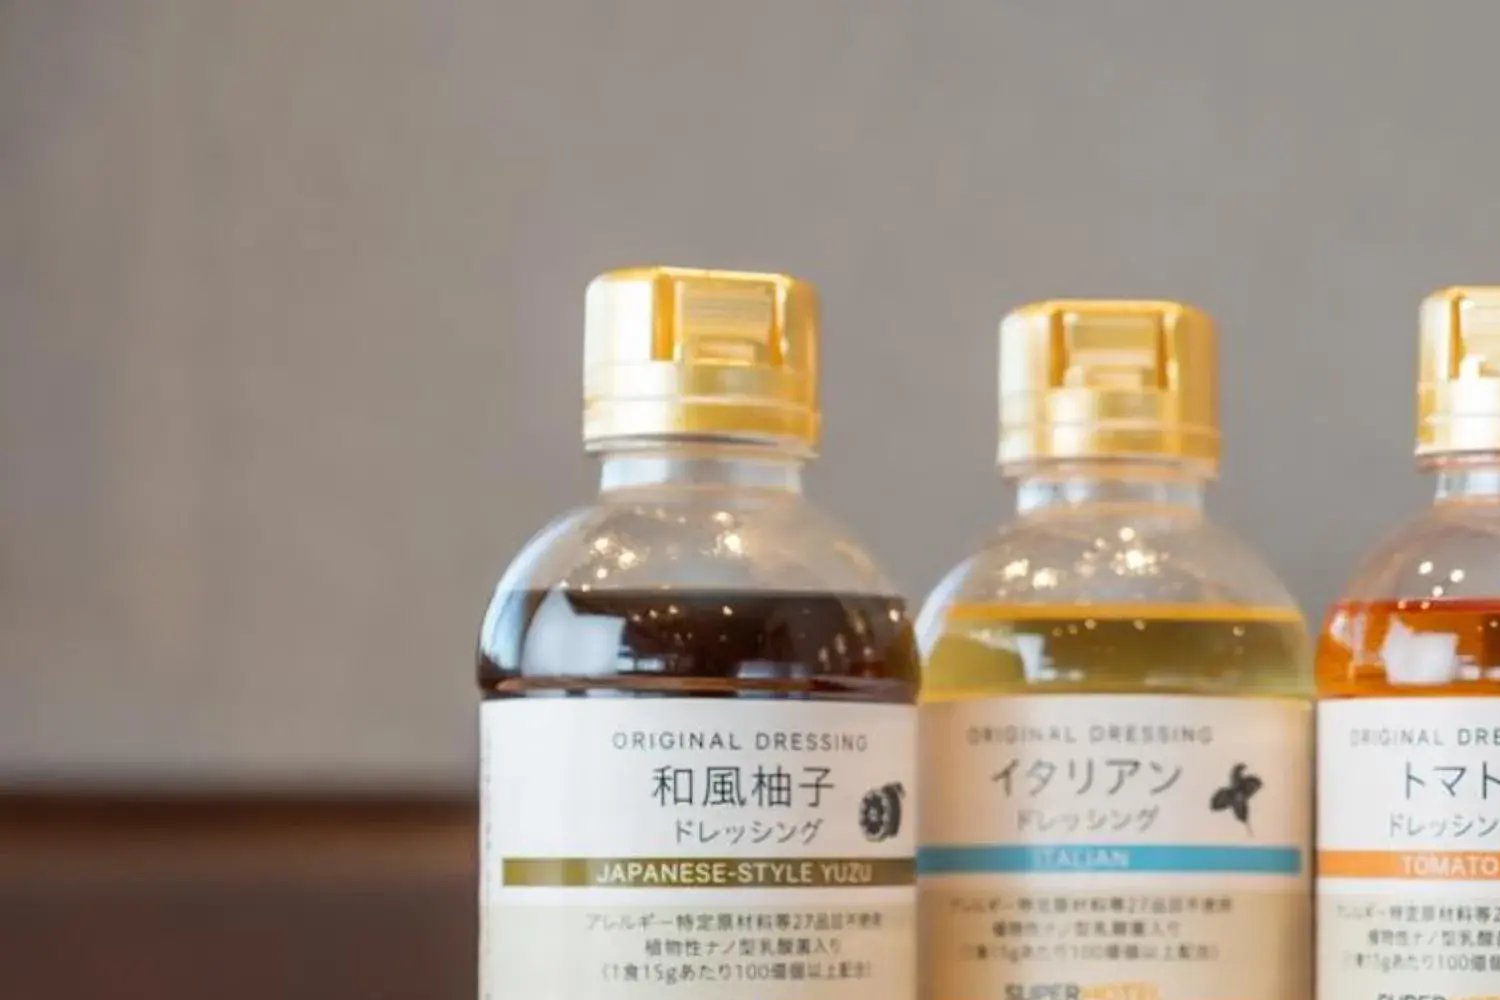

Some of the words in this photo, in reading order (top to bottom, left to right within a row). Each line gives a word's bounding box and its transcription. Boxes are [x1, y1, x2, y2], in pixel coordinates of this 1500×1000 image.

[612, 731, 742, 752] ORIGINAL
[755, 732, 869, 752] DRESSING
[966, 725, 1078, 745] ORIGINAL
[1088, 724, 1215, 744] DRESSING
[1349, 728, 1444, 747] ORIGINAL
[651, 765, 836, 809] 和風柚子
[991, 758, 1184, 797] イタリアン
[1016, 805, 1161, 833] ドレッシング
[674, 817, 825, 846] ドレッシング
[1035, 850, 1131, 869] ITALIAN
[1401, 856, 1500, 877] TOMATO
[595, 862, 812, 884] JAPANESE-STYLE
[819, 862, 873, 883] YUZU
